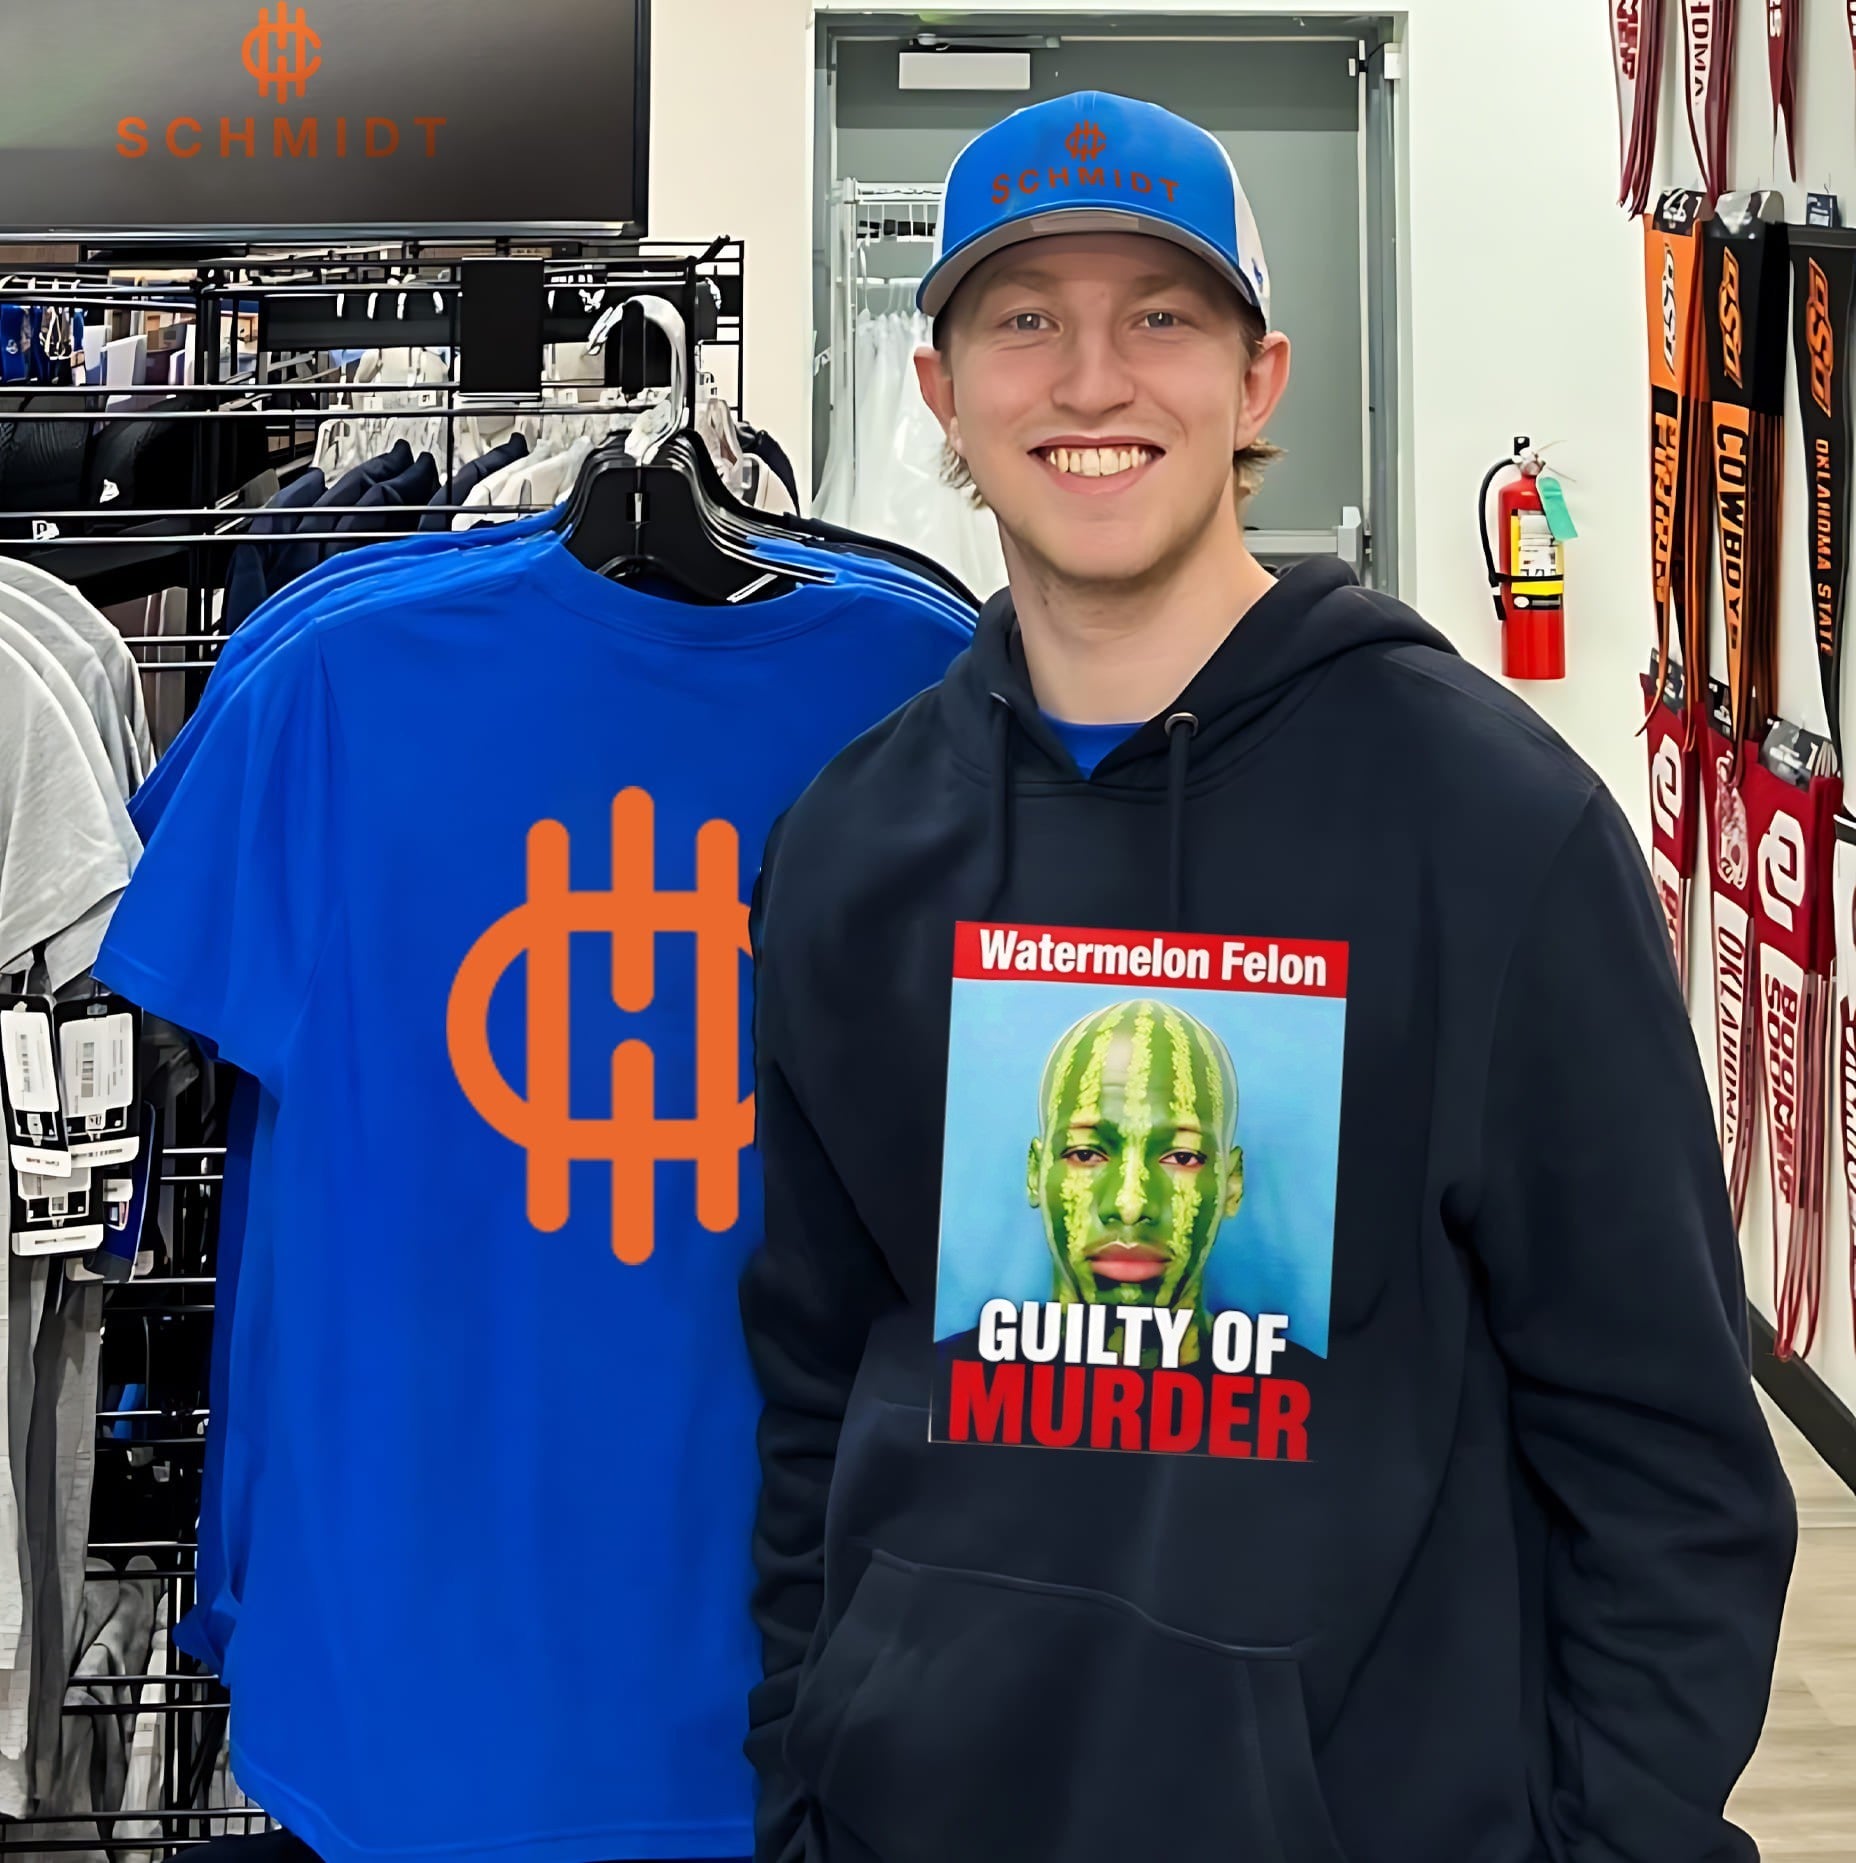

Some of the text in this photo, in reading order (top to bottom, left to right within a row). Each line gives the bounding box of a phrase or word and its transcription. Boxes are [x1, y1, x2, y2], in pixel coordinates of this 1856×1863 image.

[115, 116, 449, 159] SCHMIDT
[991, 166, 1180, 205] SCHMIDT
[979, 928, 1327, 987] Watermelon Felon
[977, 1298, 1289, 1375] GUILTY OF
[948, 1359, 1312, 1461] MURDER
